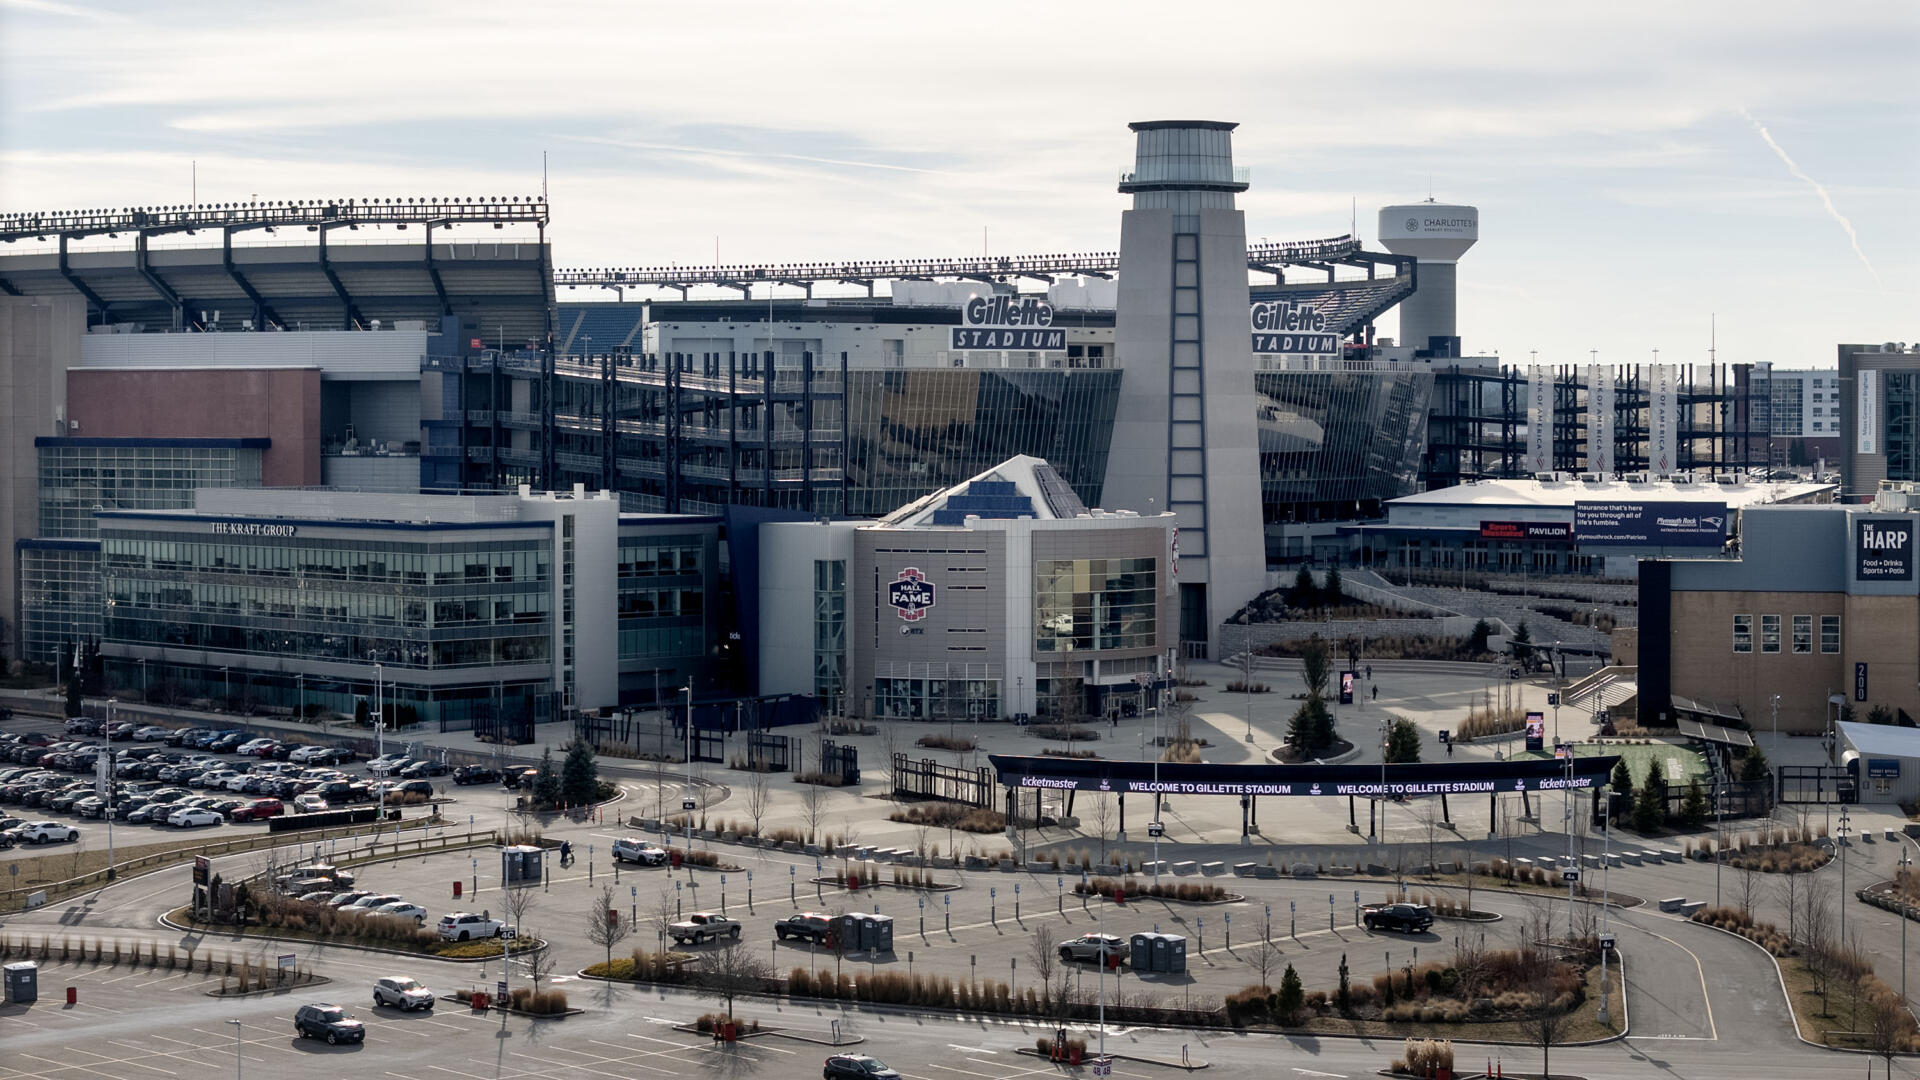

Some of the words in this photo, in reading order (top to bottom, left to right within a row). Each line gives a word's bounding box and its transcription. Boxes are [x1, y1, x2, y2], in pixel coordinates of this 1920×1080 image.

[966, 296, 1052, 326] Gillette
[1252, 303, 1325, 332] Gillette
[958, 331, 1062, 348] STADIUM
[1256, 336, 1334, 351] TADIUM
[1536, 395, 1543, 406] OF
[1596, 395, 1603, 406] OF
[1660, 395, 1666, 406] OF
[211, 522, 228, 534] THE
[231, 523, 261, 535] KRAFT
[263, 524, 294, 536] GROUP
[1864, 531, 1907, 549] HARP
[892, 592, 931, 604] FAME
[1022, 776, 1078, 788] ticketmaster
[1129, 782, 1179, 792] WELCOME
[1181, 784, 1194, 792] TO
[1196, 784, 1244, 793] GILLETTE
[1245, 785, 1291, 794] STADIUM
[1337, 784, 1388, 794] WELCOME
[1390, 784, 1404, 793] TO
[1405, 783, 1451, 793] GILLETTE
[1452, 782, 1494, 792] STADIUM
[1539, 777, 1592, 789] ticketmaster
